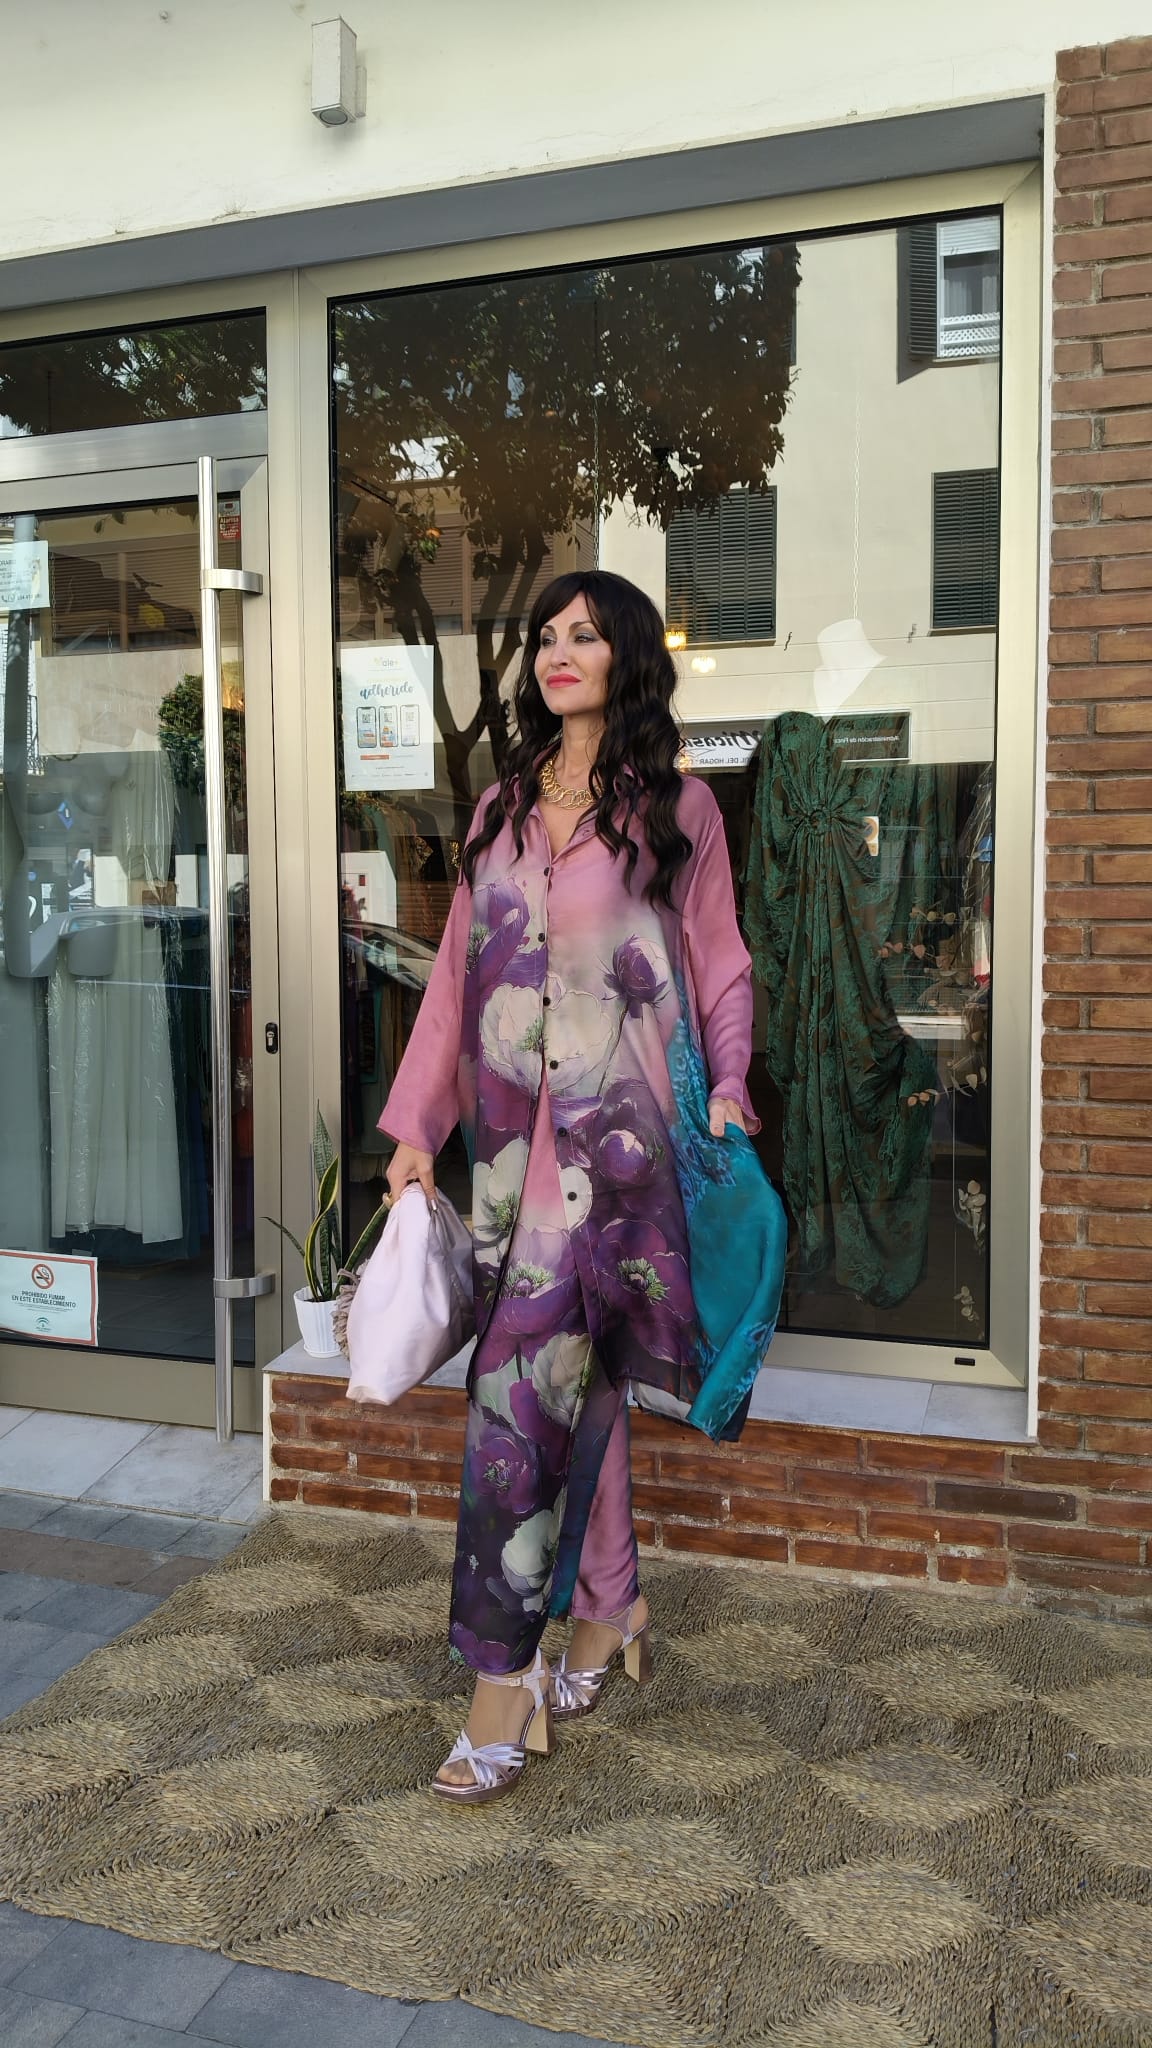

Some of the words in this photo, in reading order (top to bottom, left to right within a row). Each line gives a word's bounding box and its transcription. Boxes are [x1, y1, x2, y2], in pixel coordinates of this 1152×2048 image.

[360, 681, 414, 700] adherido
[21, 1290, 48, 1299] PROHIBIDO
[49, 1293, 65, 1301] FUMAR
[33, 1298, 76, 1308] ESTABLECIMIENTO
